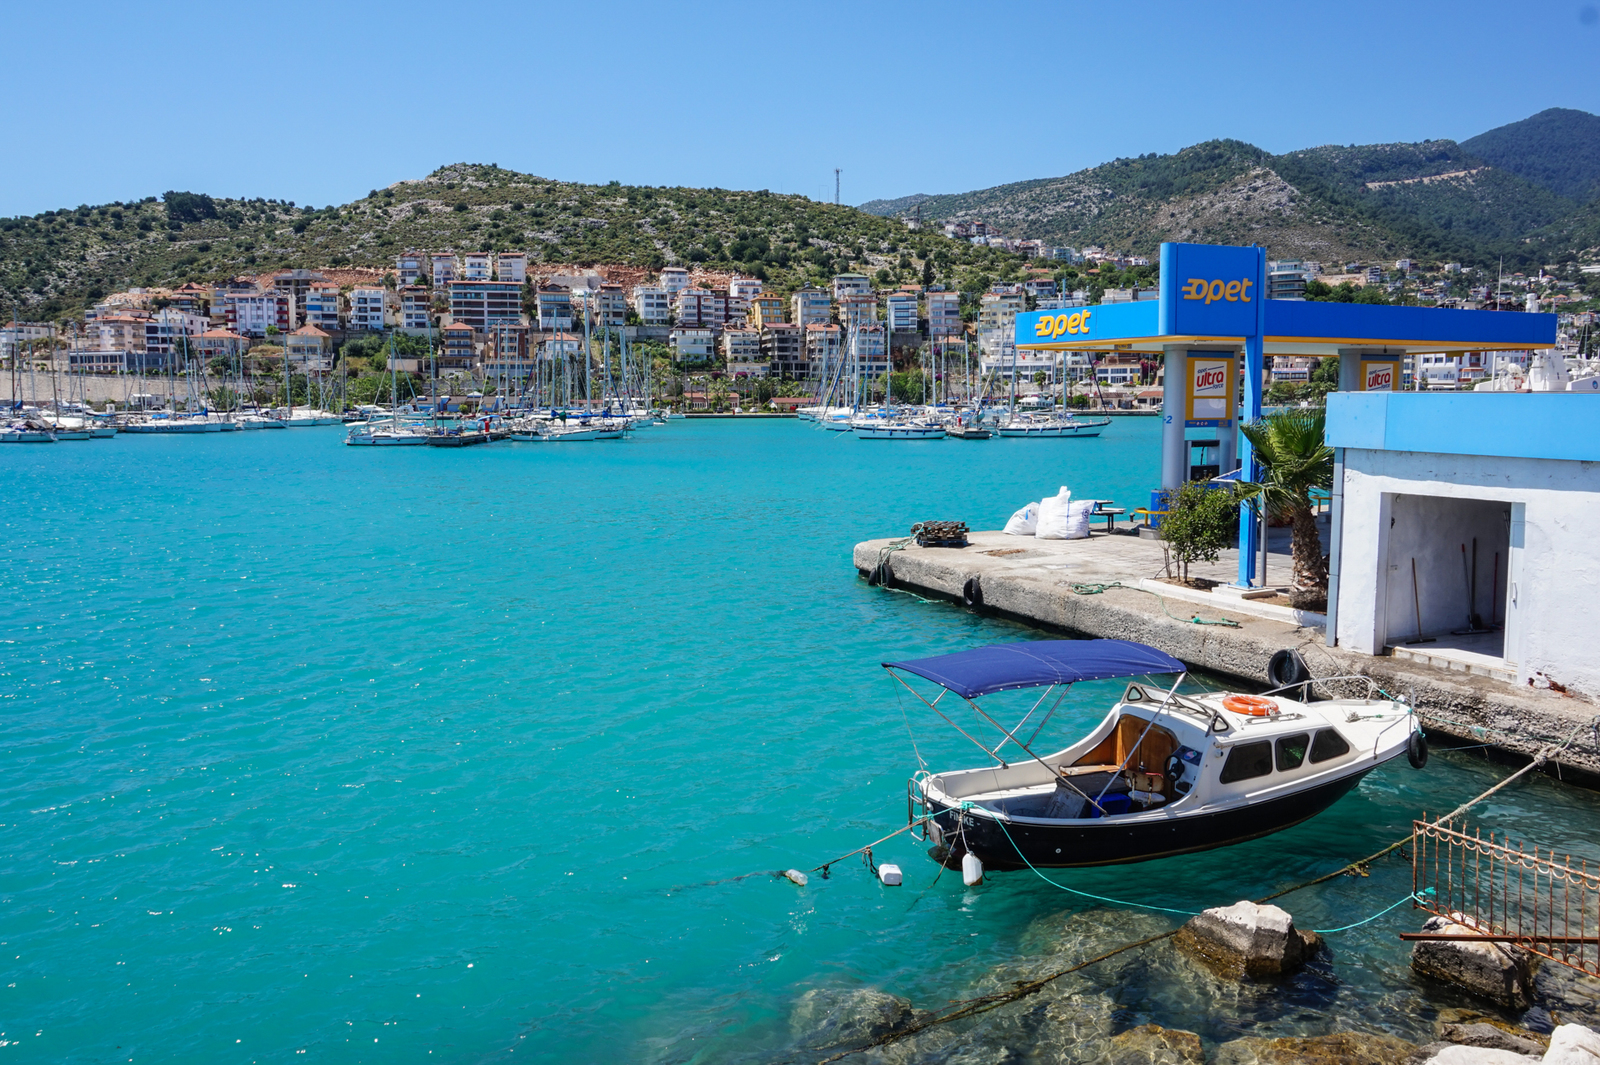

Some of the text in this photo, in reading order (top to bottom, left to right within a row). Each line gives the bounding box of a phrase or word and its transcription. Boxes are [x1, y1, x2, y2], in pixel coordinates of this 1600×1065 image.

[1181, 277, 1253, 305] opet
[1035, 309, 1092, 339] opet
[1197, 371, 1224, 387] ultra
[1368, 373, 1390, 387] ultra
